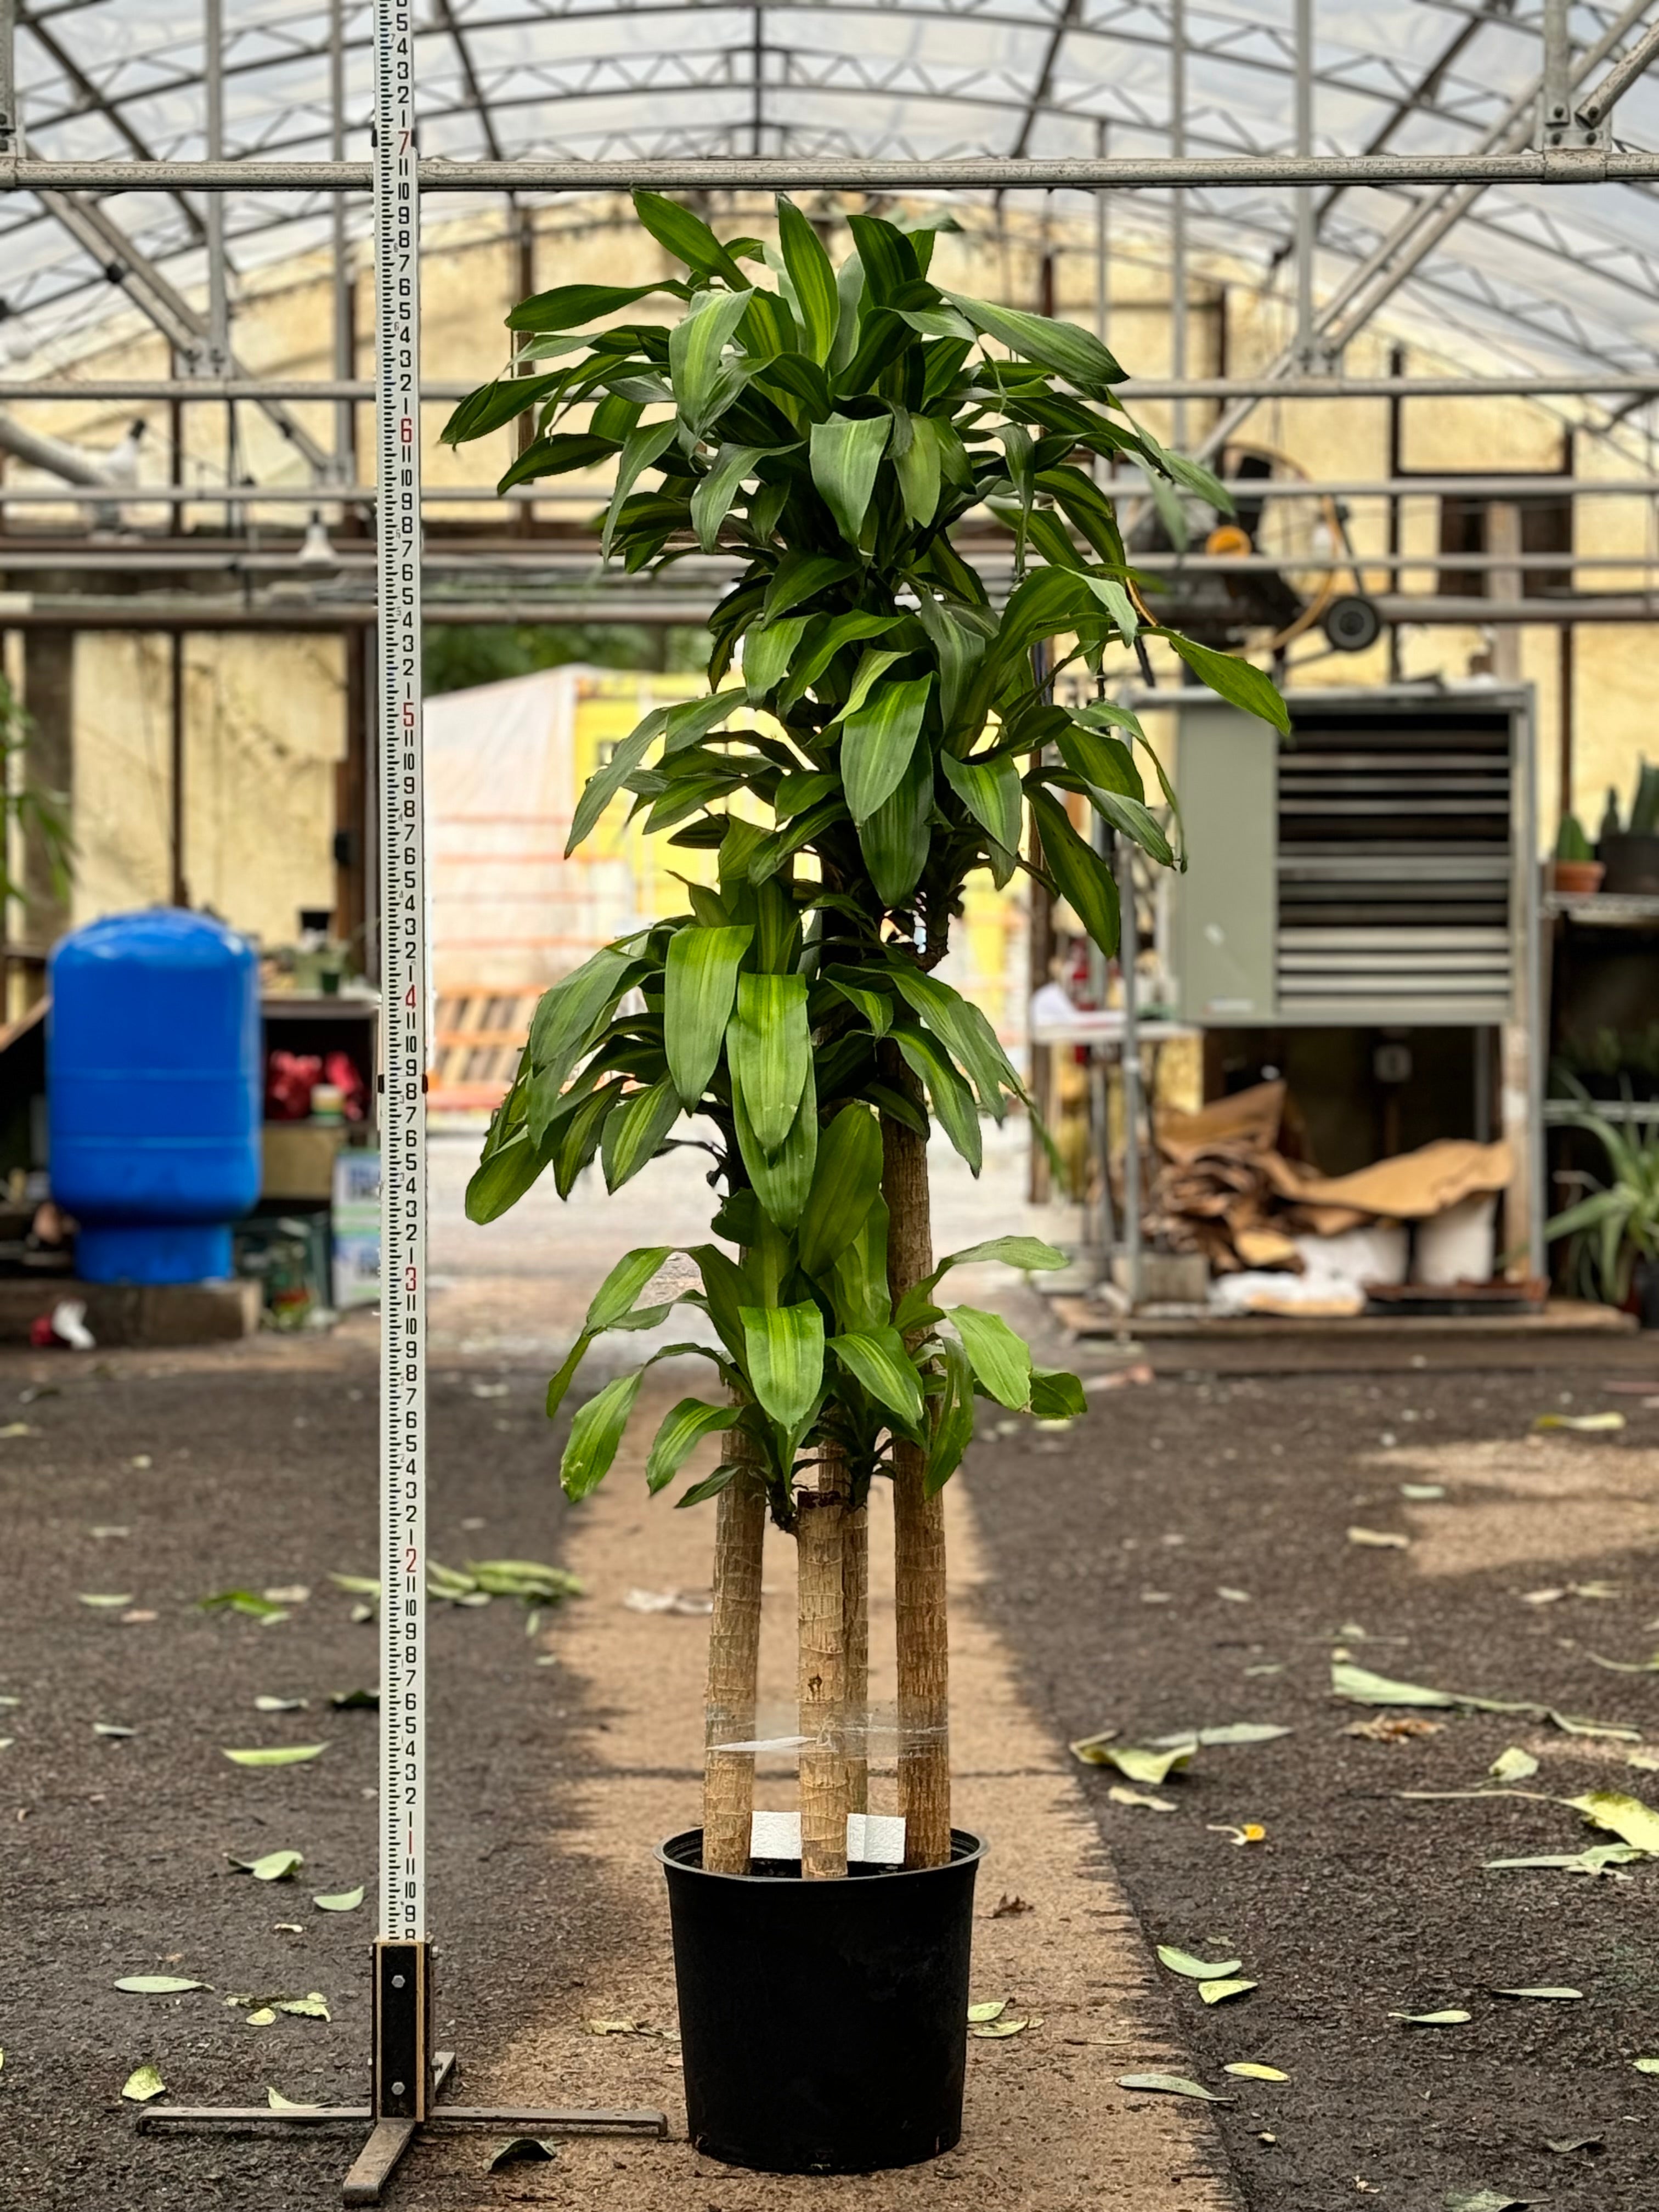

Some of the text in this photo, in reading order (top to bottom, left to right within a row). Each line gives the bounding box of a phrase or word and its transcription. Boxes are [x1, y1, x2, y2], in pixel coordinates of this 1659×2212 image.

[396, 13, 408, 32] 5
[397, 37, 409, 55] 4
[397, 61, 409, 80] 3
[397, 85, 409, 104] 2
[402, 109, 405, 128] 1
[398, 131, 410, 156] 7
[398, 157, 408, 177] 11
[398, 182, 410, 201] 10
[398, 206, 410, 224] 9
[398, 230, 410, 249] 8
[398, 254, 410, 273] 7
[399, 278, 410, 296] 6
[399, 301, 411, 320] 5
[399, 325, 411, 343] 4
[399, 349, 411, 368] 3
[399, 373, 411, 392] 2
[404, 397, 408, 415] 1
[400, 417, 412, 443] 6
[402, 444, 411, 463] 11
[401, 469, 413, 487] 10
[401, 492, 413, 511] 9
[401, 516, 413, 534] 8
[402, 540, 413, 558] 7
[402, 563, 413, 582] 6
[402, 587, 414, 606] 5
[401, 610, 413, 629] 4
[402, 634, 414, 652] 3
[403, 658, 414, 676] 2
[407, 681, 410, 699] 1
[403, 702, 415, 727] 5
[404, 729, 414, 747] 11
[403, 752, 415, 771] 10
[403, 776, 415, 794] 9
[403, 800, 415, 819] 8
[404, 823, 416, 842] 7
[404, 847, 416, 865] 6
[404, 870, 416, 889] 5
[404, 893, 416, 912] 4
[404, 917, 416, 936] 3
[405, 941, 416, 960] 2
[409, 964, 413, 983] 1
[405, 984, 416, 1010] 4
[406, 1011, 416, 1030] 11
[405, 1035, 417, 1053] 10
[405, 1058, 417, 1077] 9
[405, 1082, 417, 1101] 8
[405, 1106, 417, 1124] 7
[405, 1129, 417, 1148] 6
[405, 1153, 417, 1171] 5
[405, 1176, 417, 1194] 4
[405, 1200, 417, 1218] 3
[405, 1223, 417, 1242] 2
[409, 1246, 413, 1265] 1
[405, 1266, 416, 1292] 3
[407, 1294, 416, 1312] 11
[405, 1317, 417, 1335] 10
[405, 1340, 417, 1359] 9
[405, 1364, 417, 1382] 8
[405, 1387, 417, 1406] 7
[405, 1410, 417, 1429] 6
[405, 1434, 417, 1452] 5
[405, 1457, 417, 1476] 4
[405, 1481, 417, 1499] 3
[405, 1505, 417, 1522] 2
[409, 1528, 413, 1546] 1
[405, 1548, 417, 1573] 2
[407, 1575, 416, 1593] 11
[405, 1599, 417, 1617] 10
[405, 1622, 416, 1640] 9
[405, 1645, 417, 1664] 8
[405, 1669, 416, 1687] 7
[405, 1692, 416, 1711] 6
[405, 1716, 416, 1734] 5
[404, 1739, 416, 1757] 4
[405, 1763, 416, 1781] 3
[405, 1787, 416, 1804] 2
[409, 1810, 413, 1828] 1
[408, 1830, 413, 1855] 1
[406, 1857, 415, 1876] 11
[404, 1881, 416, 1899] 10
[404, 1904, 416, 1923] 9
